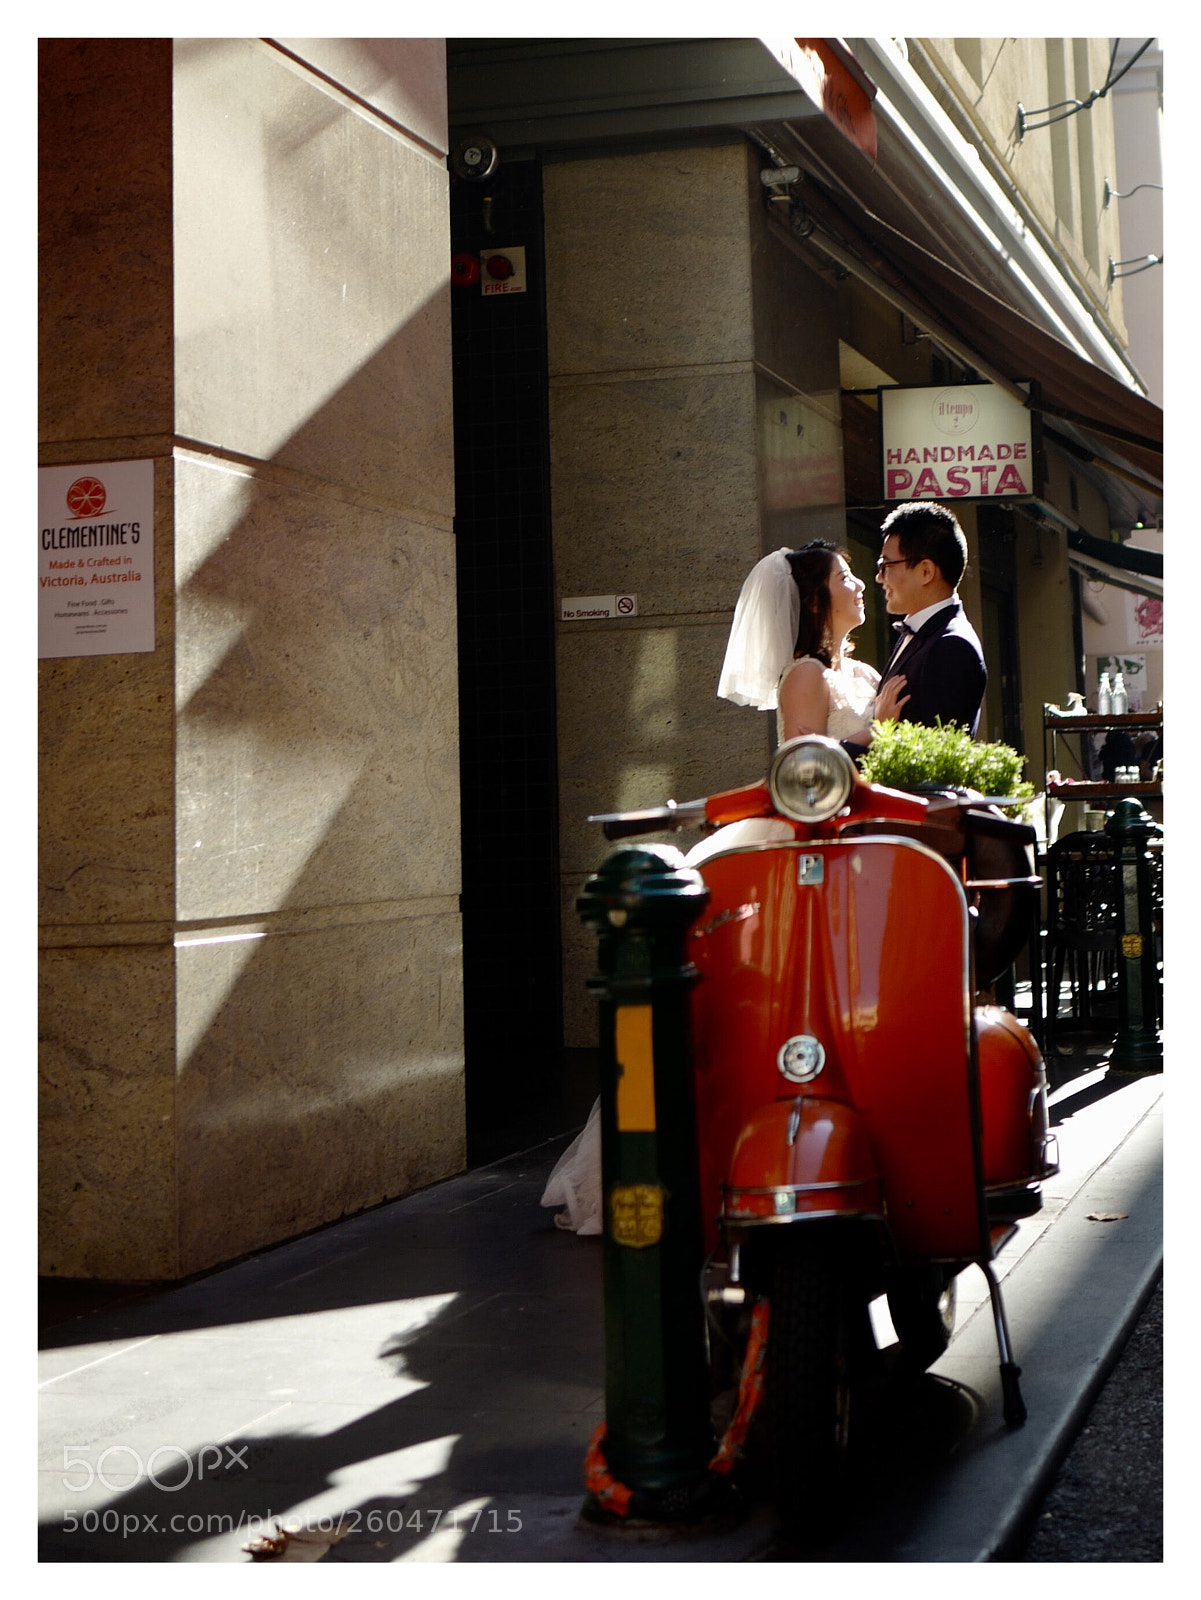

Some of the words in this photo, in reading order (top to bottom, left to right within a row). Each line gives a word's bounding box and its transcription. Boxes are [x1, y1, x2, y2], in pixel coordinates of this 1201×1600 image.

[484, 282, 509, 294] FIRE
[946, 403, 974, 418] tempo
[886, 442, 1028, 465] HANDMADE
[886, 463, 1028, 499] PASTA
[41, 522, 141, 551] CLEMENTINE'S
[48, 560, 76, 570] Made
[77, 559, 85, 568] &
[86, 555, 122, 568] Crafted
[123, 555, 133, 565] in
[39, 574, 88, 588] Victoria,
[91, 570, 142, 584] Australia
[81, 599, 98, 607] Food
[93, 607, 129, 616] Accessories
[563, 610, 575, 619] No
[576, 608, 610, 617] Smoking
